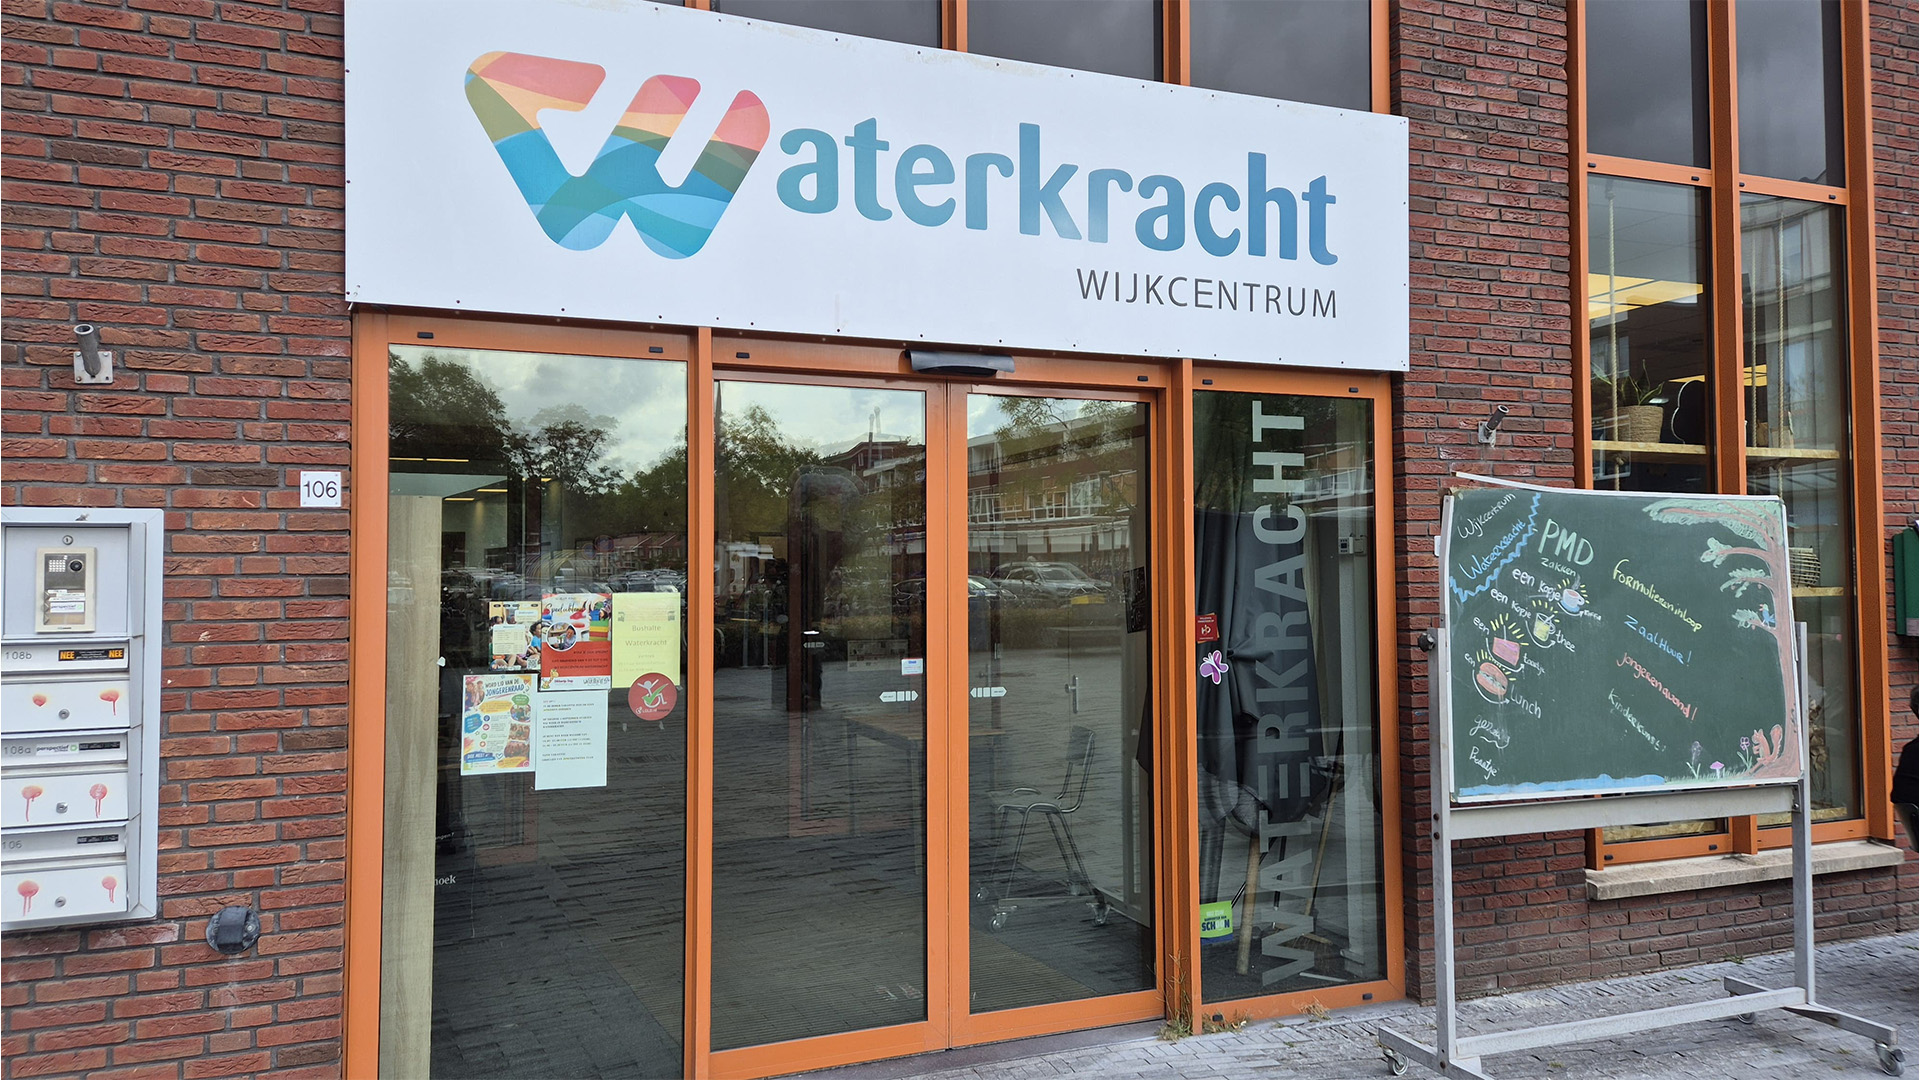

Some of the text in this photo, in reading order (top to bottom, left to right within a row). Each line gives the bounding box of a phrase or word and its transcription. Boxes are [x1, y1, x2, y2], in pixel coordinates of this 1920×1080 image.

[465, 50, 1339, 266] Waterkracht
[1076, 268, 1337, 319] WIJKCENTRUM
[303, 480, 337, 499] 106
[1538, 518, 1594, 566] PMD
[1512, 568, 1535, 587] een
[1472, 616, 1490, 635] een
[1490, 588, 1509, 605] een
[1555, 629, 1577, 653] thee
[625, 639, 667, 647] Waterkracht
[5, 651, 33, 660] 108b
[60, 651, 75, 660] NEE
[108, 650, 123, 658] NEE
[1252, 399, 1316, 988] WATERKRACHT
[4, 745, 31, 755] 108a
[2, 840, 23, 850] 106
